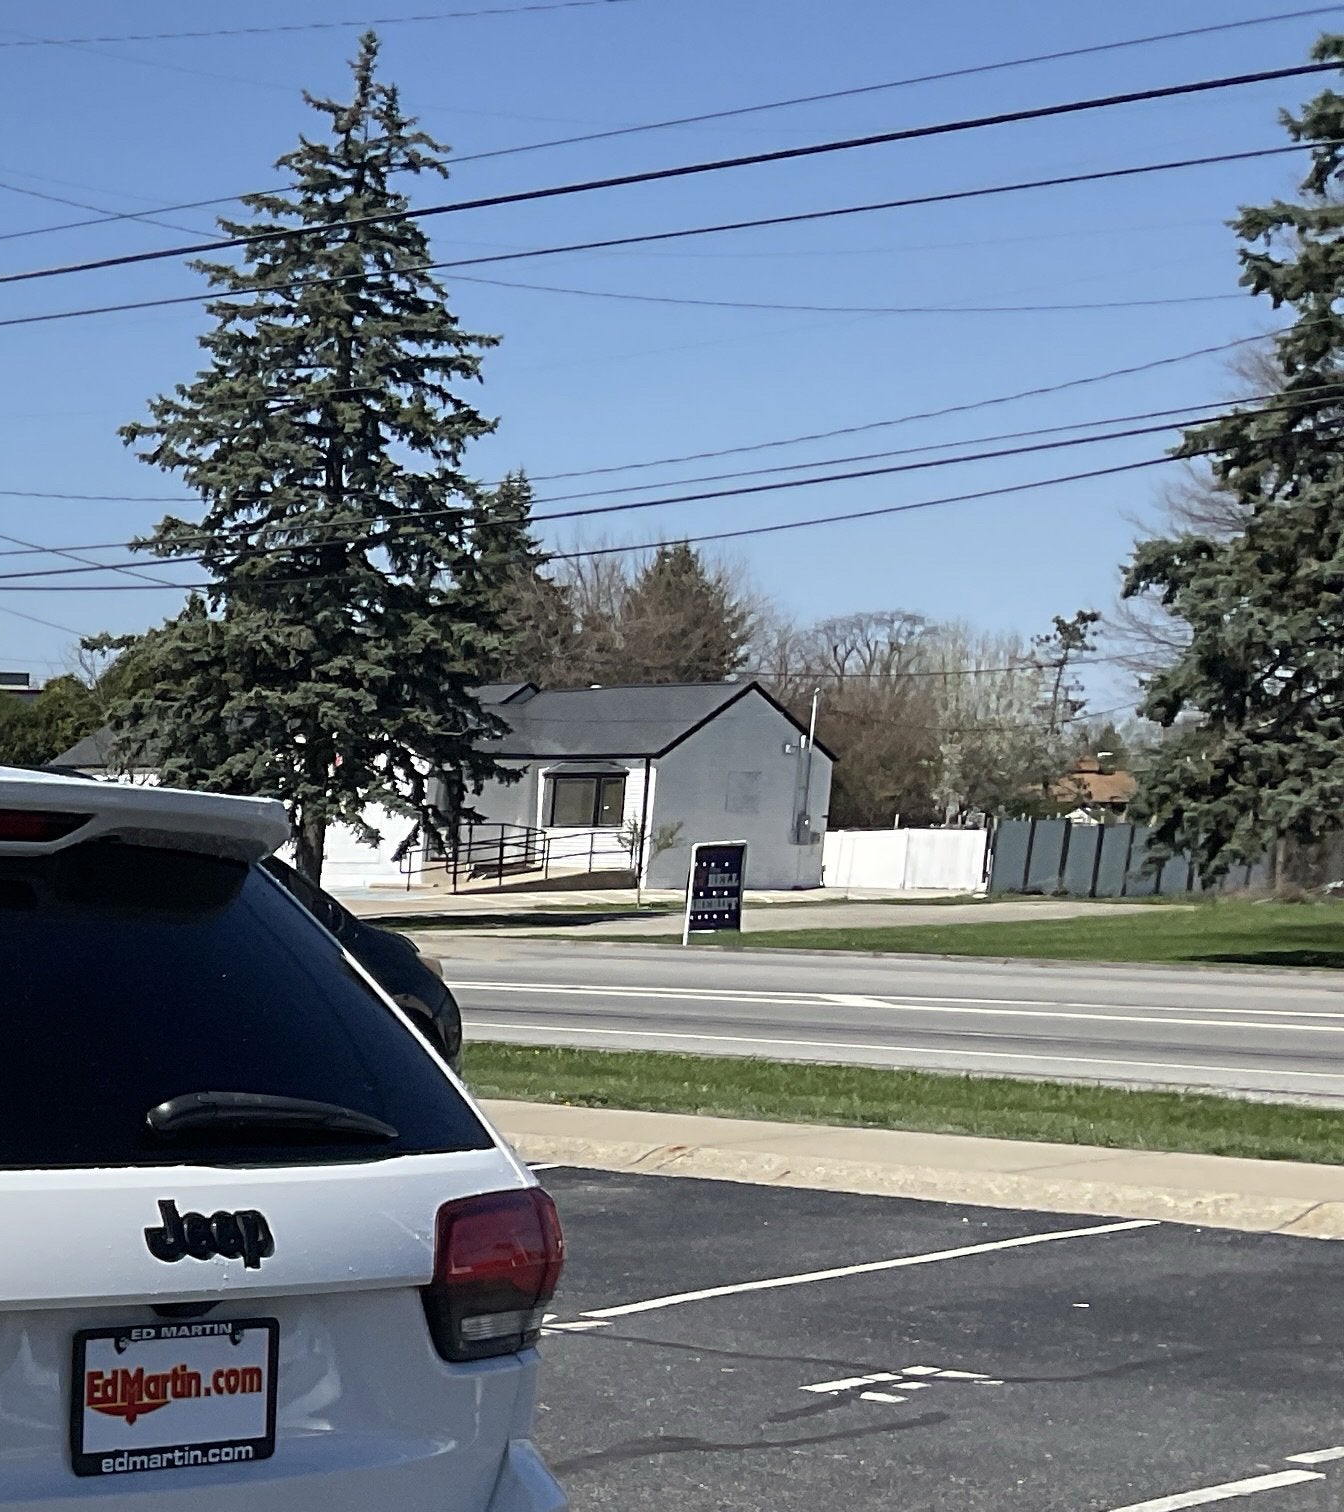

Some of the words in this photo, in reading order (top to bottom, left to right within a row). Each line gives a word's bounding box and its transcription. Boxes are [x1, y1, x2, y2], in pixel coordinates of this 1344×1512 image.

[144, 1199, 276, 1269] Jeep
[131, 1326, 156, 1341] ED
[161, 1322, 233, 1338] MARTIN
[86, 1364, 263, 1408] EdMartin.com
[101, 1445, 254, 1473] edmartin.com
